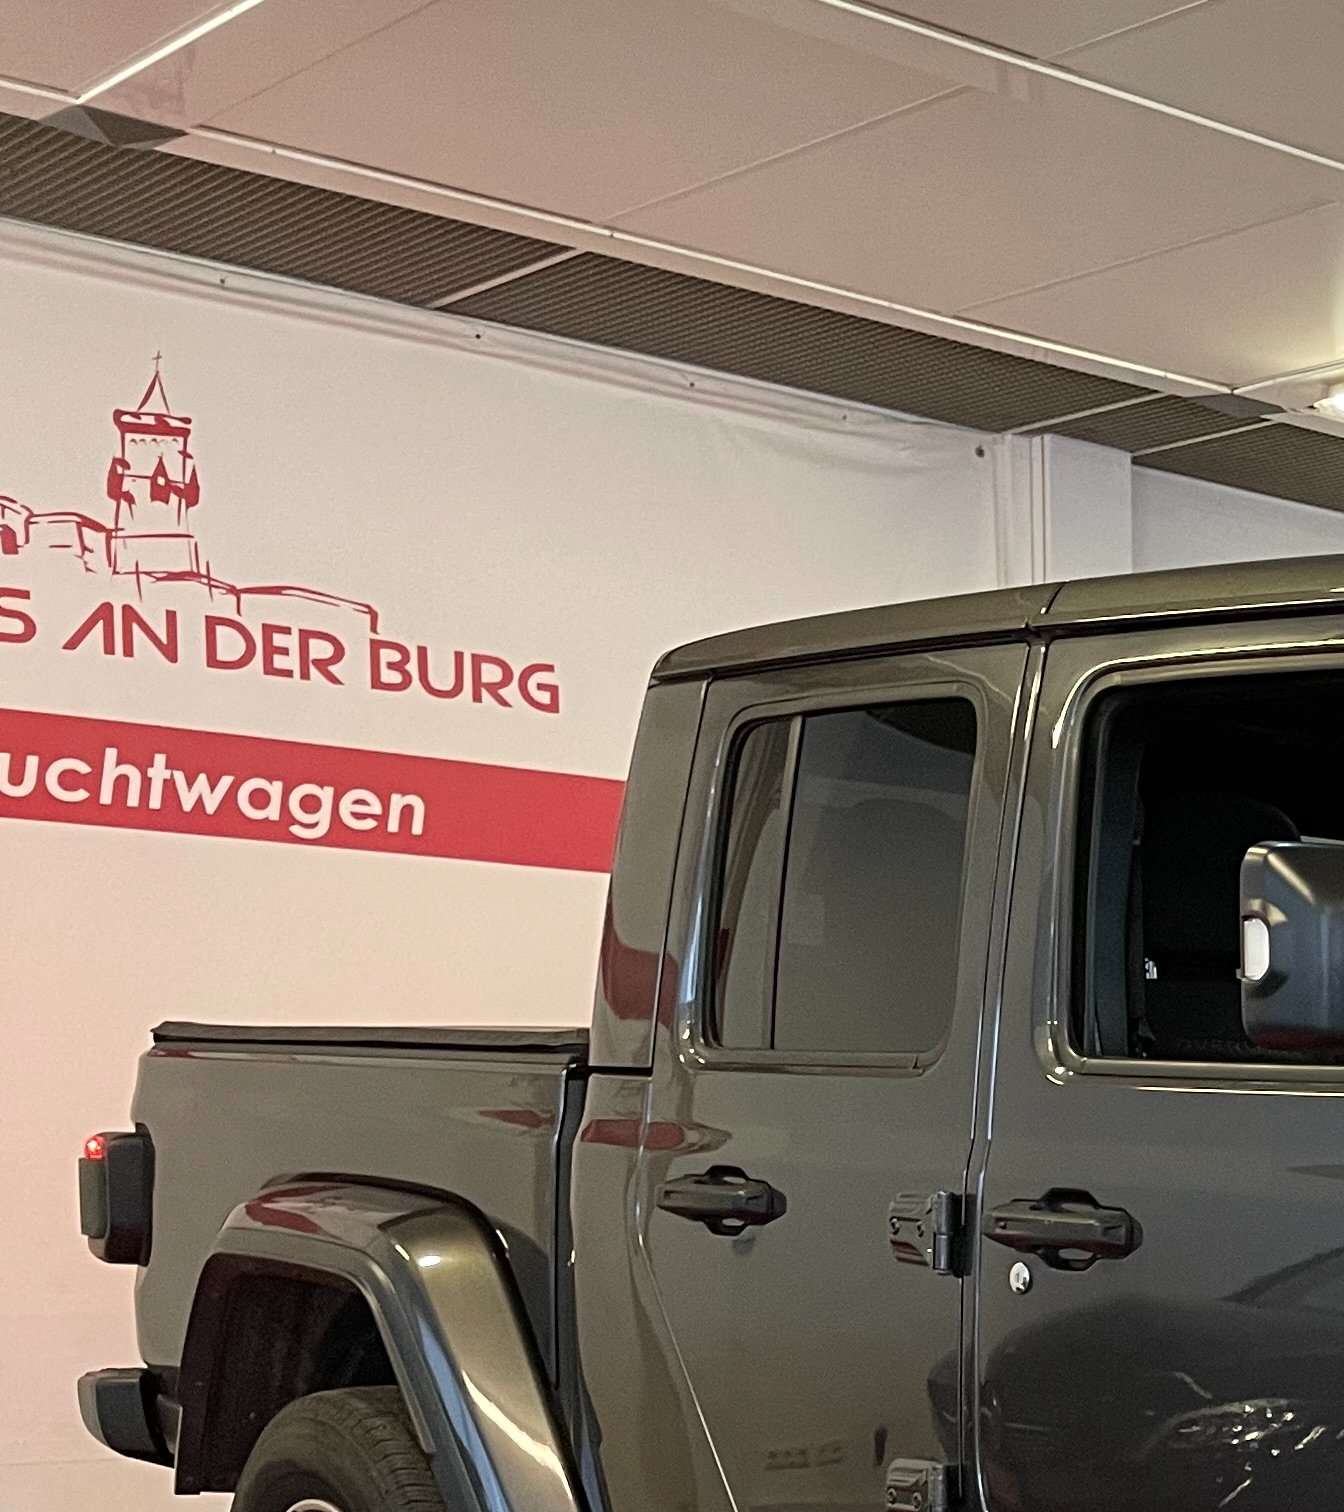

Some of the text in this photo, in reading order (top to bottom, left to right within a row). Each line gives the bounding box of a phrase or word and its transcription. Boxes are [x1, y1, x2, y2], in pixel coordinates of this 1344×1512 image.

[62, 601, 178, 664] AN
[204, 615, 346, 686] DER
[369, 637, 560, 714] BURG
[0, 747, 425, 839] uchtwagen
